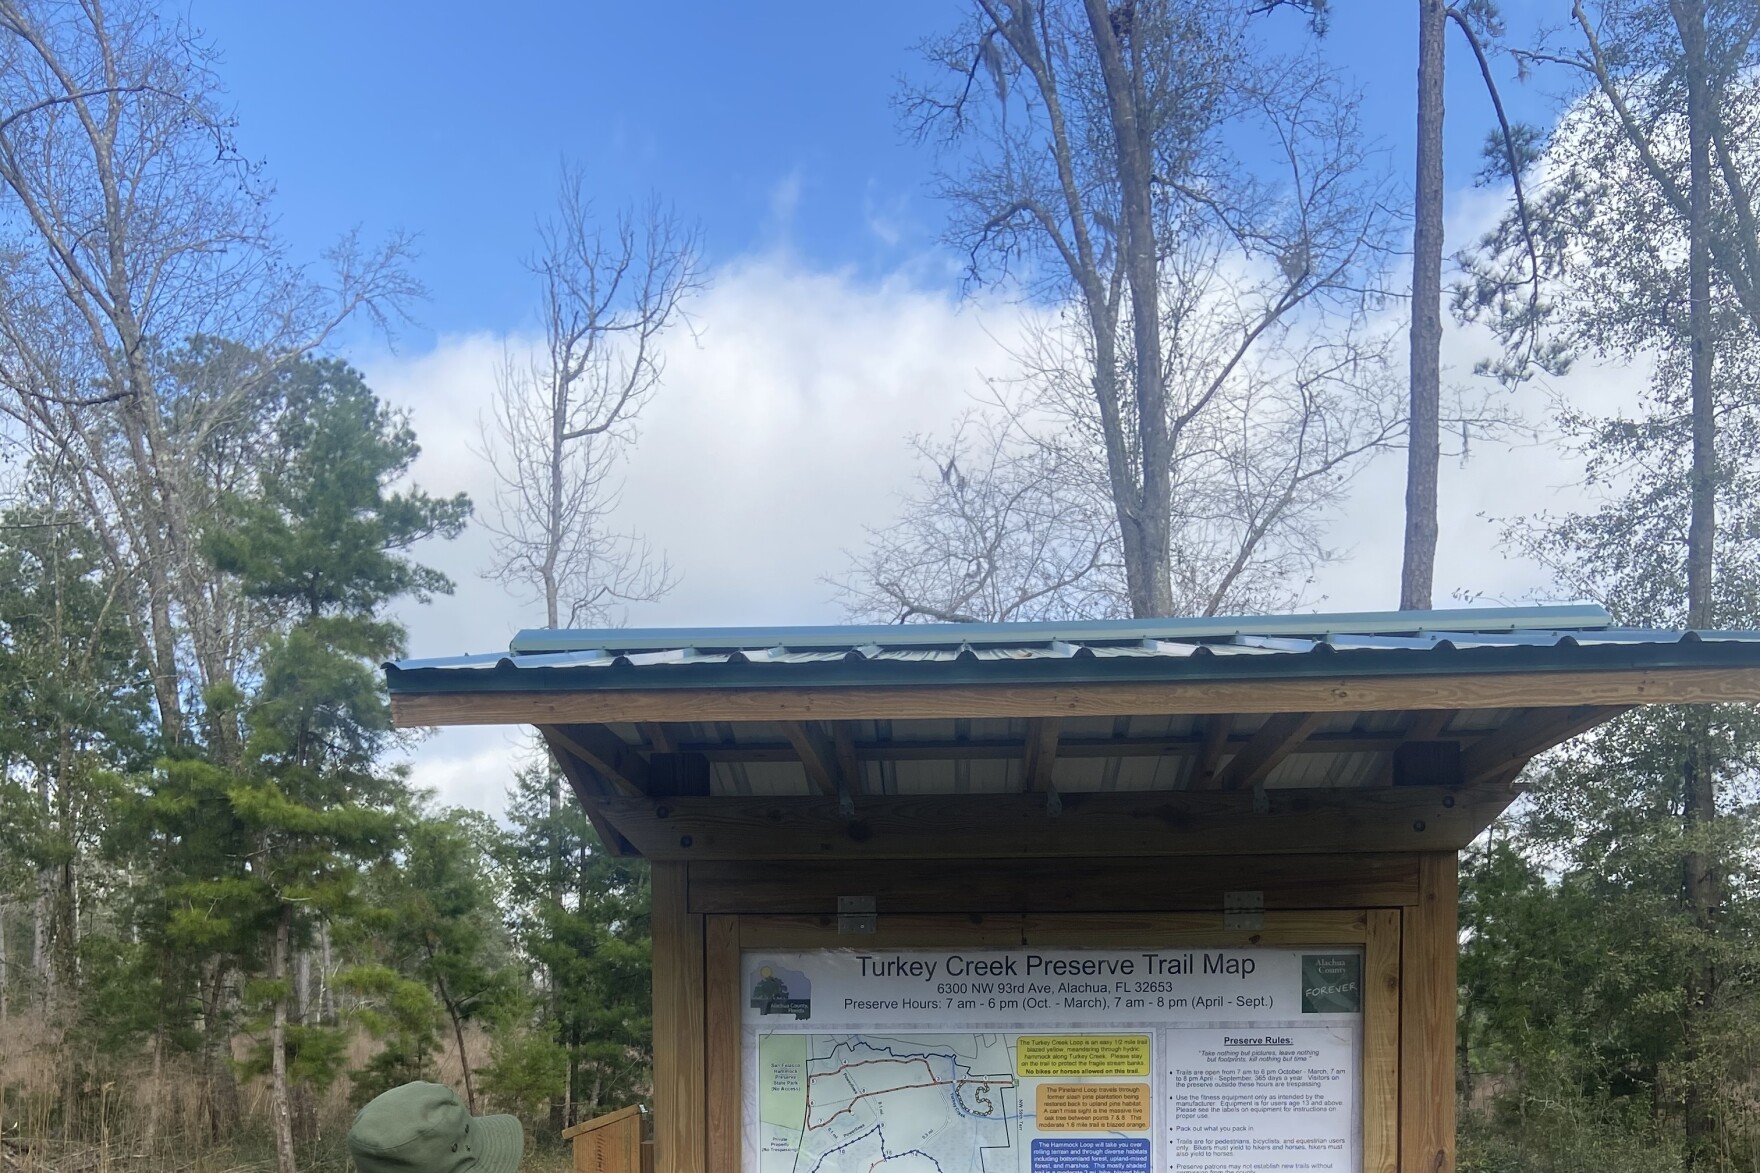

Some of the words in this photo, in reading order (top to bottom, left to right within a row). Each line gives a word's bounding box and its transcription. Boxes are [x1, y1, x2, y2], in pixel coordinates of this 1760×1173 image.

[856, 956, 937, 981] Turkey
[946, 955, 1017, 976] Creek
[1027, 955, 1134, 976] Preserve
[1142, 954, 1193, 974] Trail
[1203, 954, 1255, 979] Map
[1316, 958, 1346, 967] Alachua
[1319, 967, 1346, 975] County
[937, 983, 967, 994] 6300
[971, 983, 993, 994] NW
[998, 982, 1025, 994] 93rd
[1027, 982, 1055, 996] Ave,
[1058, 982, 1111, 995] Alachua,
[1115, 982, 1132, 993] FL
[1134, 982, 1173, 993] 32653
[1305, 982, 1357, 997] FOREVER
[845, 998, 898, 1010] Preserve
[902, 998, 942, 1009] Hours:
[946, 998, 953, 1009] 7
[957, 1001, 976, 1009] am
[988, 998, 996, 1009] 6
[1000, 1000, 1019, 1012] pm
[1022, 997, 1051, 1011] (Oct.
[1065, 997, 1110, 1010] March),
[1114, 997, 1122, 1008] 7
[1125, 999, 1145, 1008] am
[1157, 996, 1165, 1007] 8
[1168, 999, 1187, 1010] pm
[1192, 996, 1224, 1010] (April
[1236, 996, 1274, 1010] Sept.)
